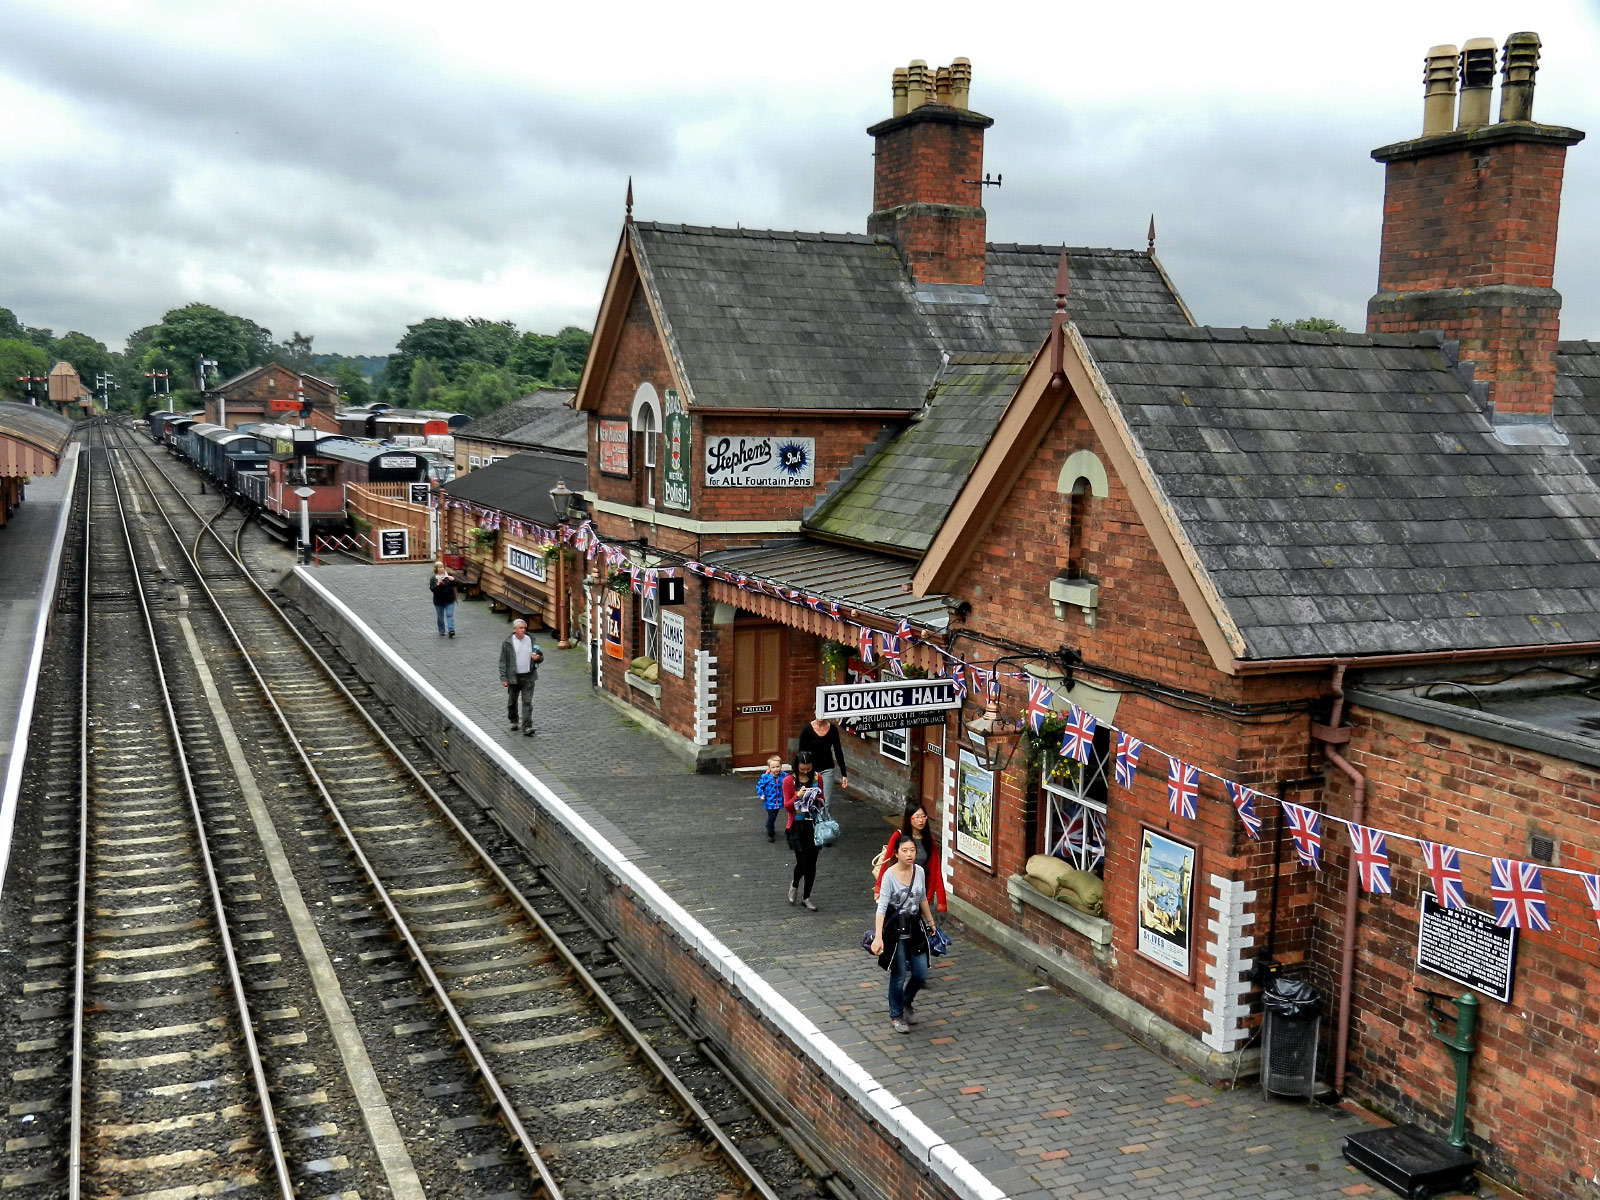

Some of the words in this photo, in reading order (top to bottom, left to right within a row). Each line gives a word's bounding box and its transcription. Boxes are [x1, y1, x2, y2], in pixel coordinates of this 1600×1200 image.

[709, 476, 720, 486] for
[722, 477, 742, 486] ALL
[746, 477, 786, 486] Fountain
[788, 477, 811, 486] Pens
[666, 482, 688, 504] Polish
[607, 616, 620, 638] TEA
[664, 642, 682, 666] STARCH
[828, 690, 904, 712] BOOKING
[912, 686, 952, 705] HALL
[1447, 910, 1483, 927] NOTICE
